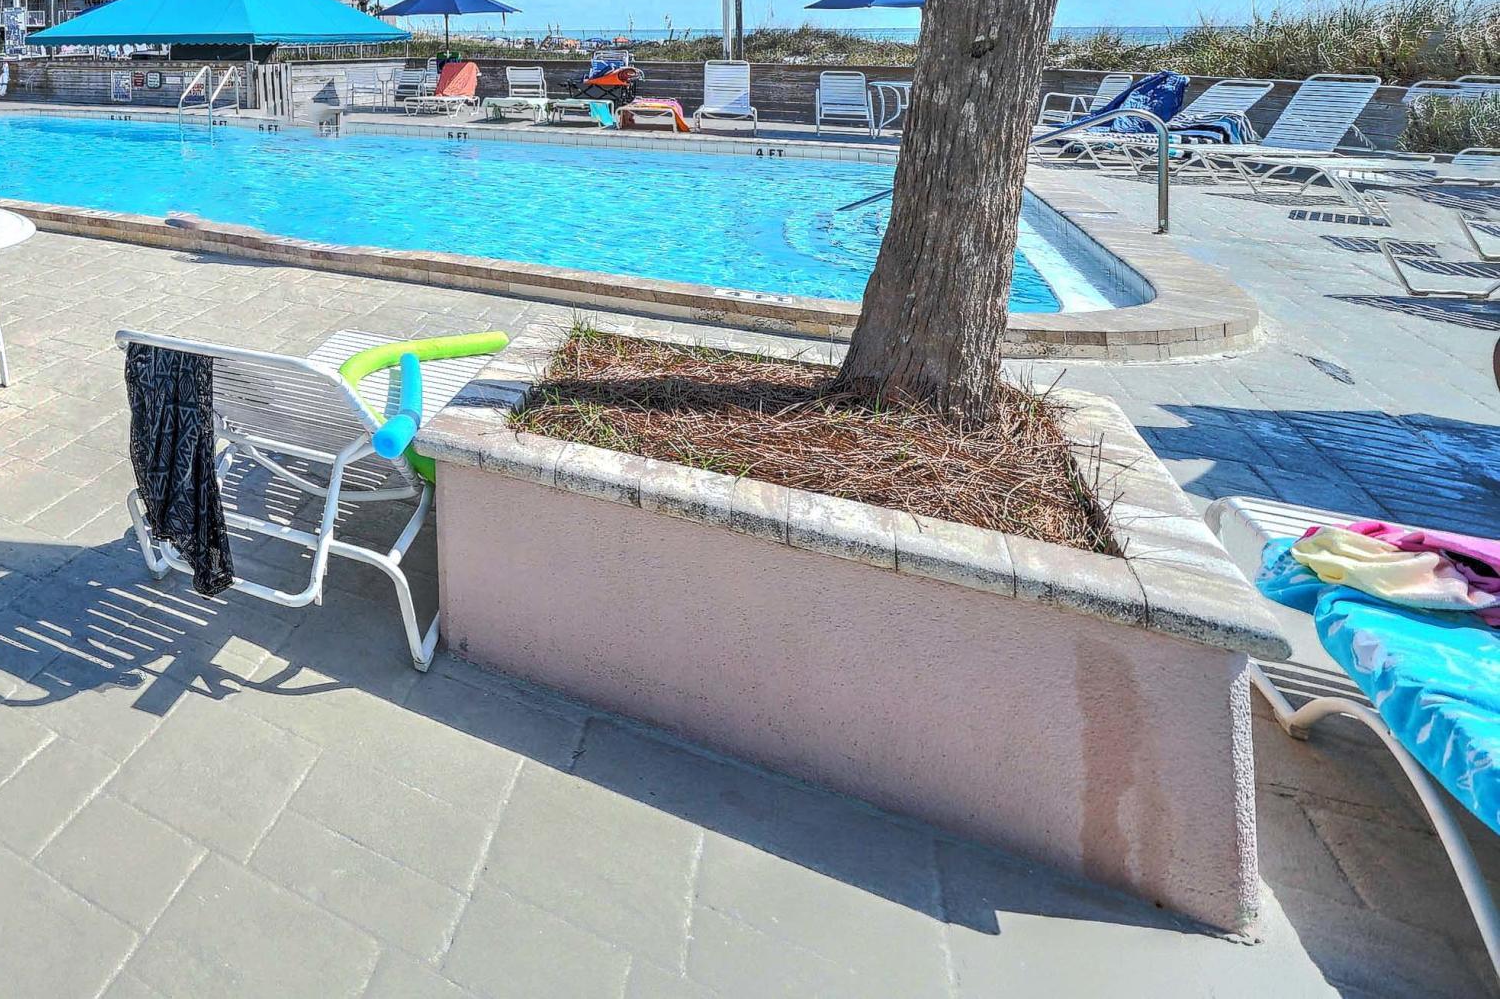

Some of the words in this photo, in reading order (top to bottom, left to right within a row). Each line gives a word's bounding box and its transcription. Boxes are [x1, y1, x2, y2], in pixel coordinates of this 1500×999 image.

[267, 124, 279, 132] FT
[457, 132, 468, 141] FT
[755, 148, 764, 156] 4
[769, 149, 784, 157] FT
